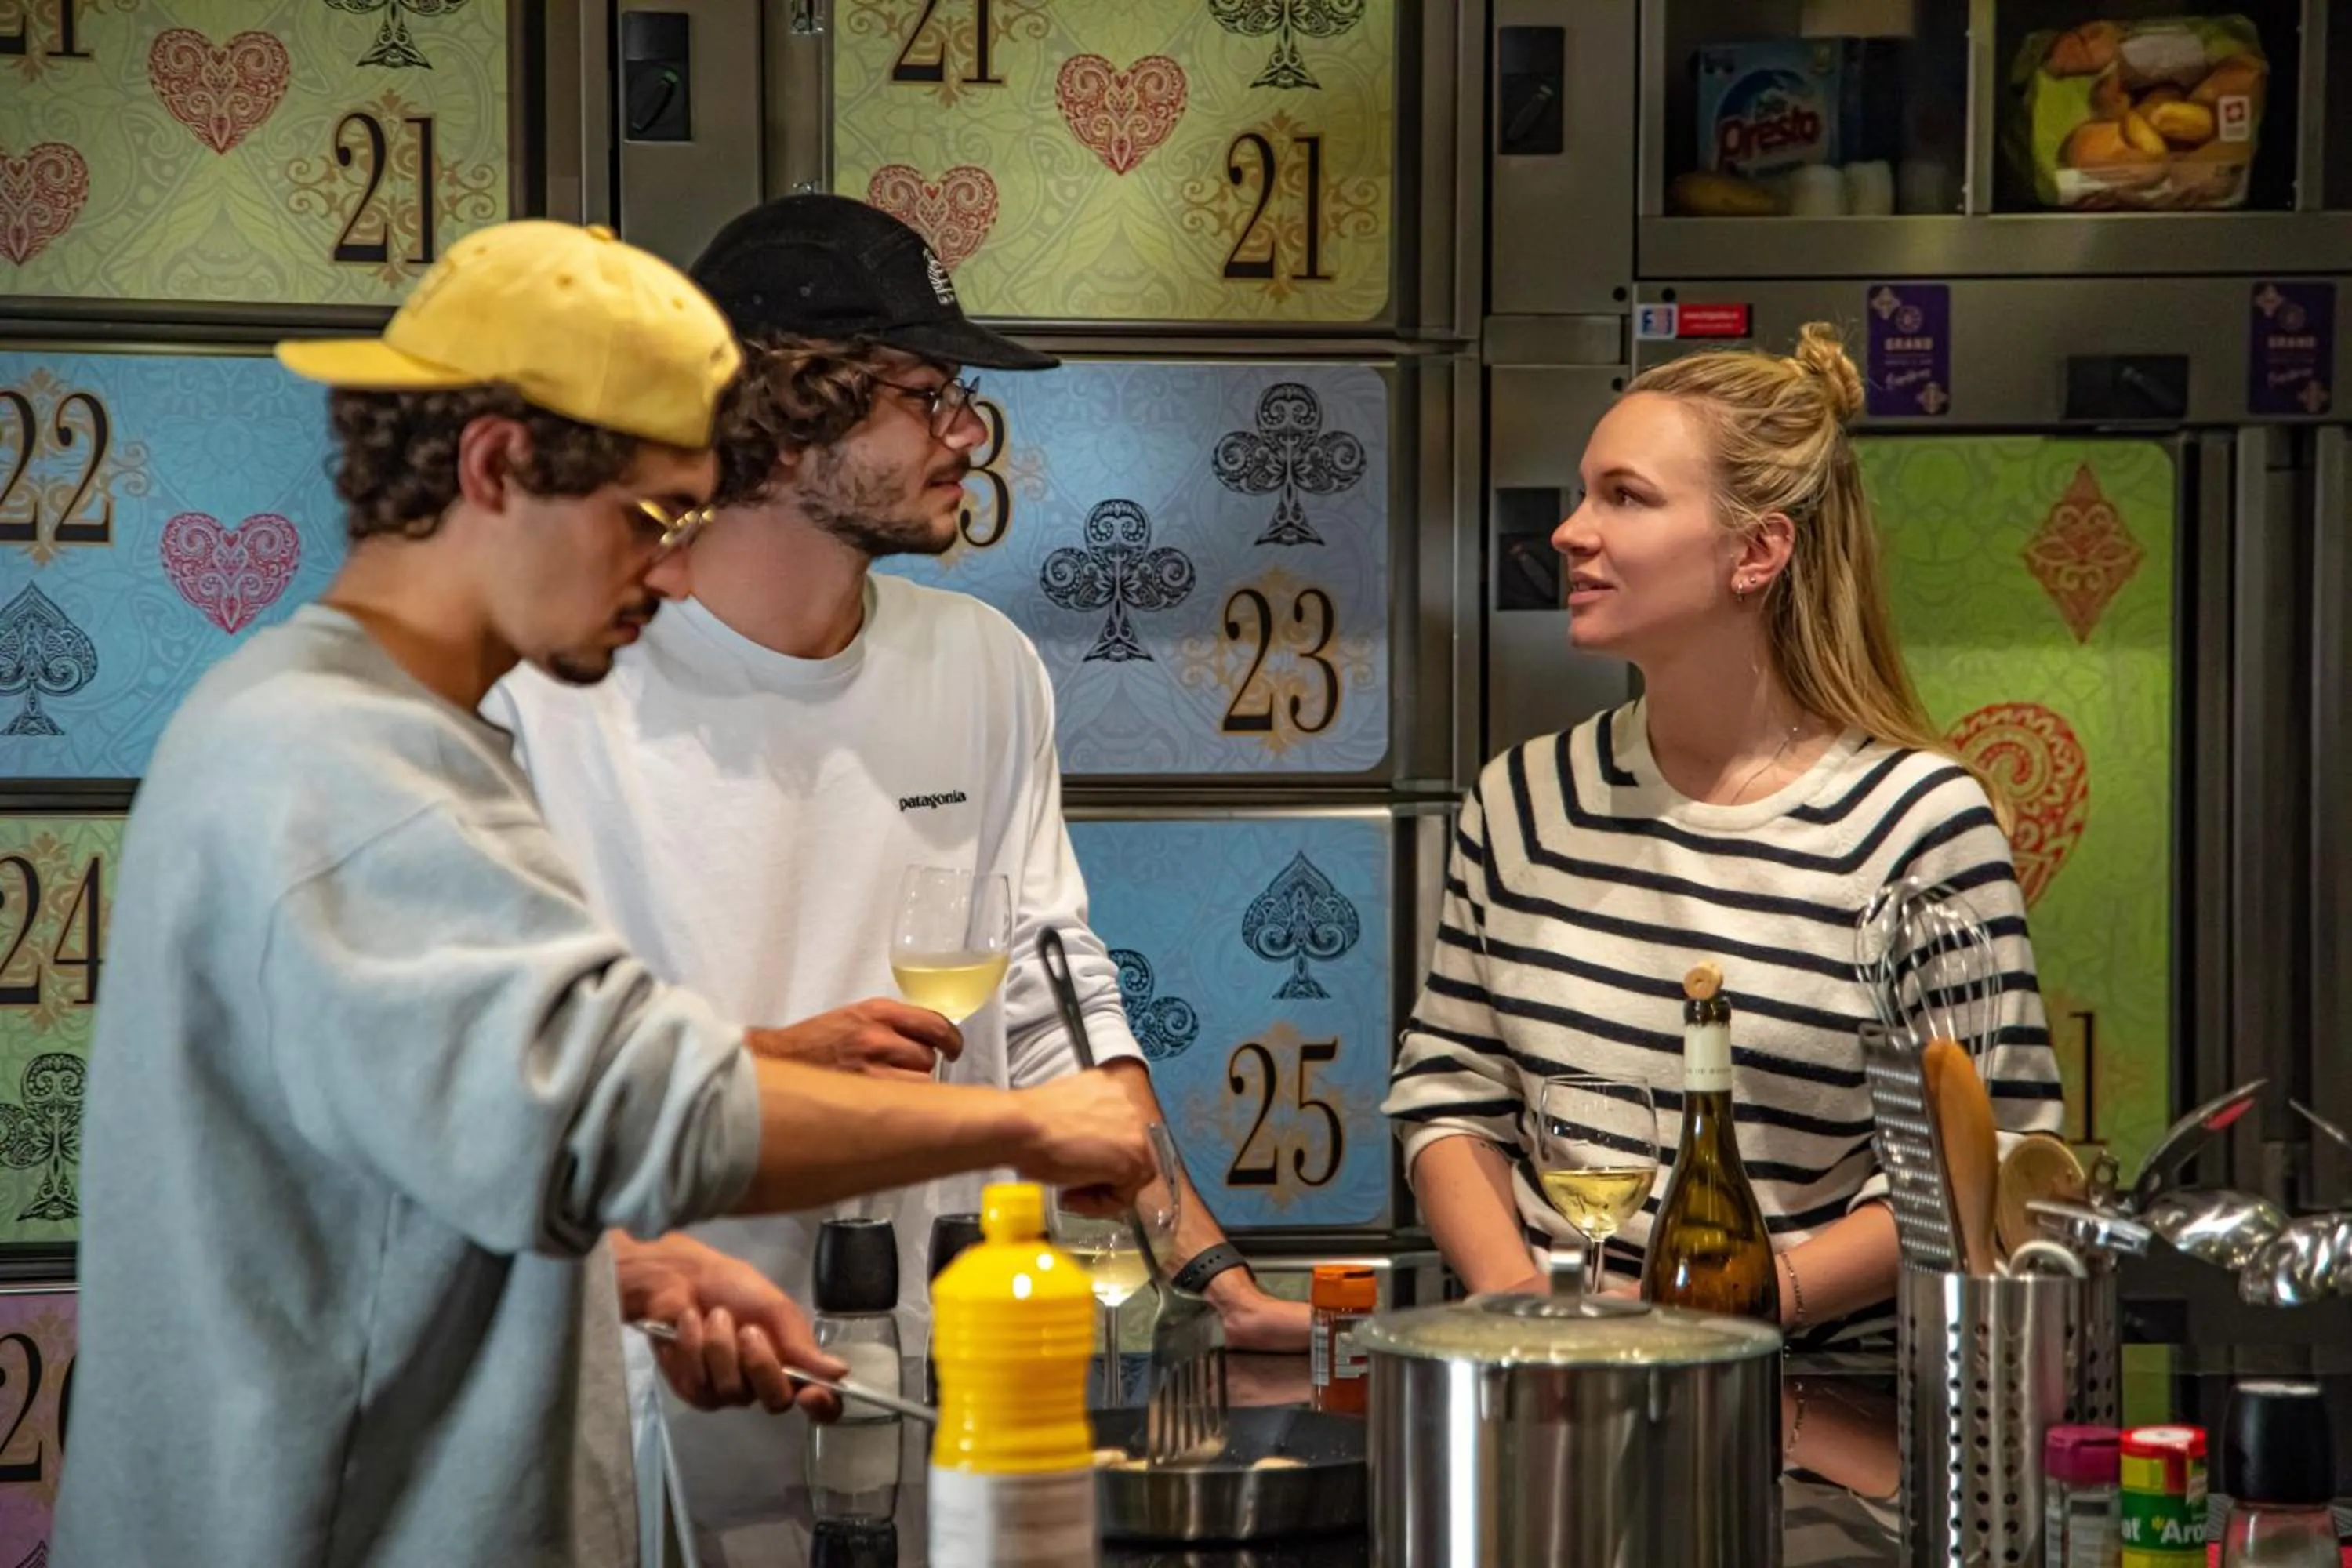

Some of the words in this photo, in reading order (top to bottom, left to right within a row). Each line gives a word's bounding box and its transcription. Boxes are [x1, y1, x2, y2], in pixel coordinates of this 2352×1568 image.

[332, 111, 435, 265] 21
[1223, 132, 1333, 281] 21
[0, 390, 110, 542] 22
[960, 401, 1010, 547] 3
[1222, 588, 1338, 733] 23
[899, 789, 967, 811] patagonia
[0, 855, 103, 1004] 24
[1227, 1039, 1344, 1187] 25
[2071, 1011, 2107, 1146] 1
[0, 1333, 76, 1483] 2
